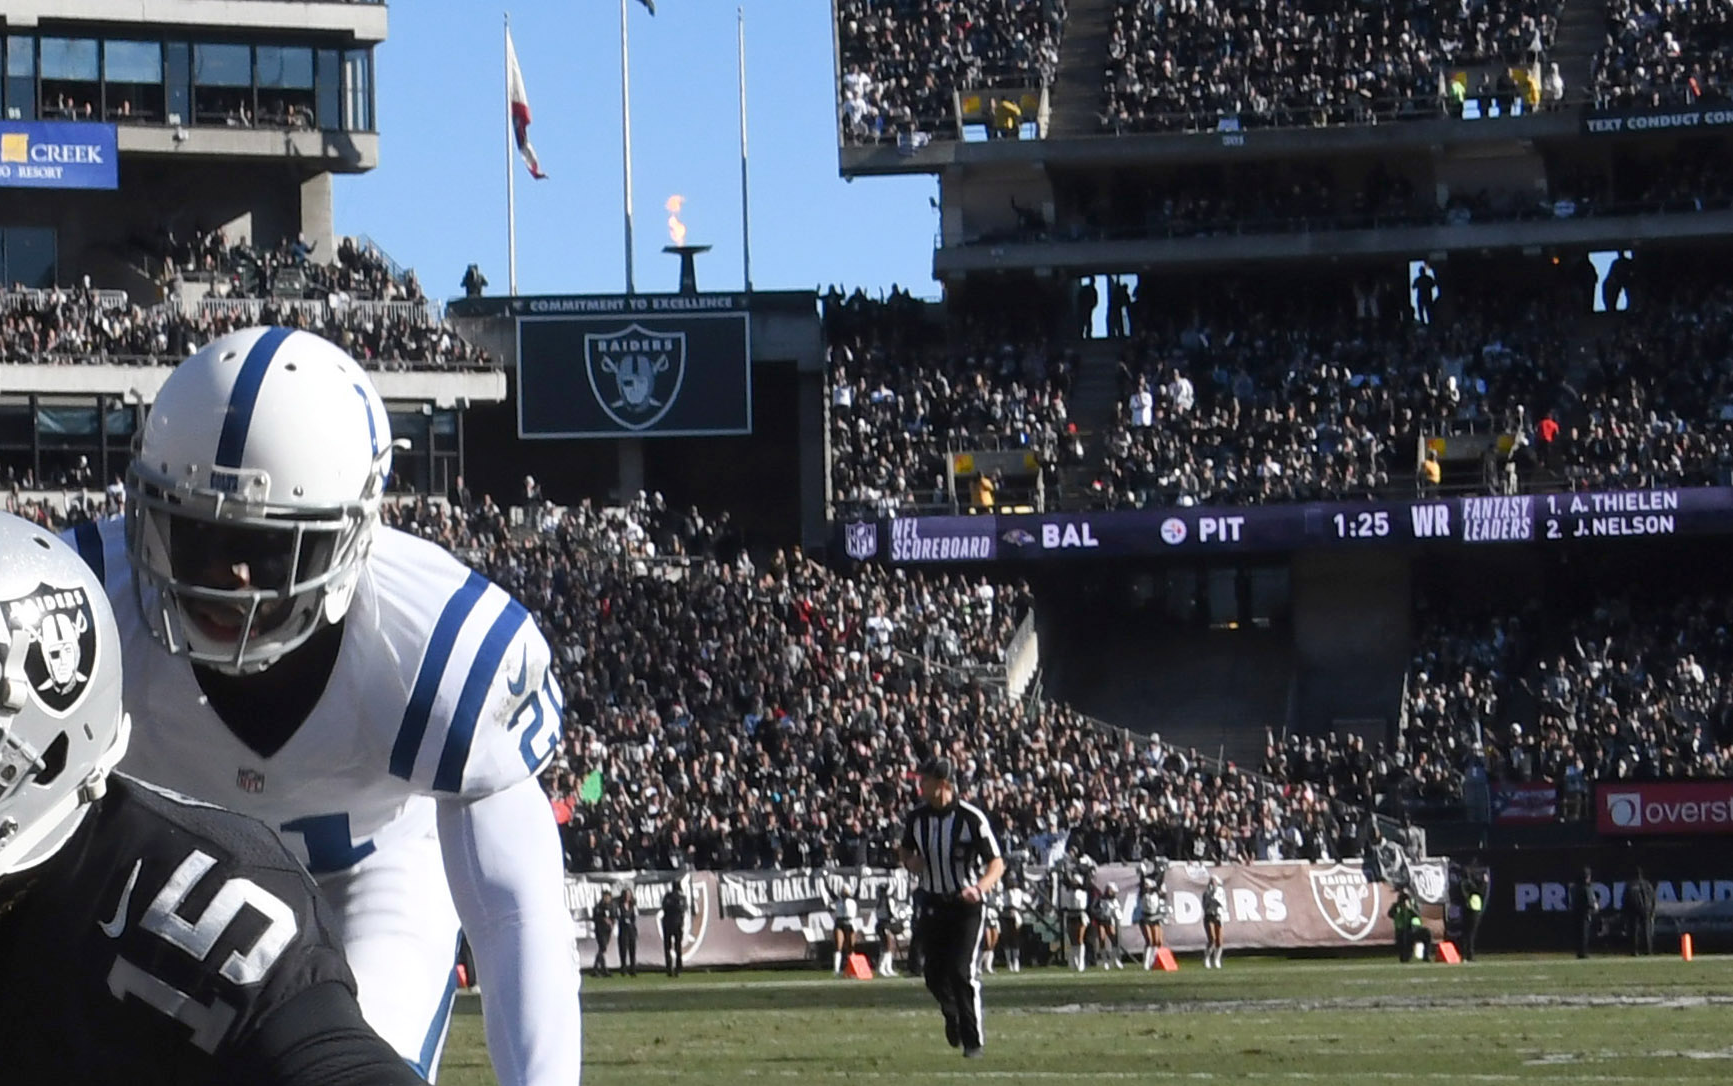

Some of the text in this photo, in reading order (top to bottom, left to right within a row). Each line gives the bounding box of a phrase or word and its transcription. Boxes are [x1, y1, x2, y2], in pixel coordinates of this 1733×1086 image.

[1587, 118, 1622, 132] TEXT
[1627, 113, 1700, 129] CONDUCT
[31, 144, 104, 164] CREEK
[18, 165, 63, 179] RESORT
[530, 297, 733, 312] COMMITMENT TO EXCELLENCE
[598, 339, 673, 352] RAIDERS
[1462, 497, 1531, 520] FANTASY
[892, 517, 918, 539] NFL
[1042, 511, 1389, 549] BAL PIT 1:25
[1411, 505, 1451, 537] WR
[1463, 517, 1532, 541] LEADERS
[891, 536, 991, 561] SCOREBOARD
[106, 849, 299, 1056] 15
